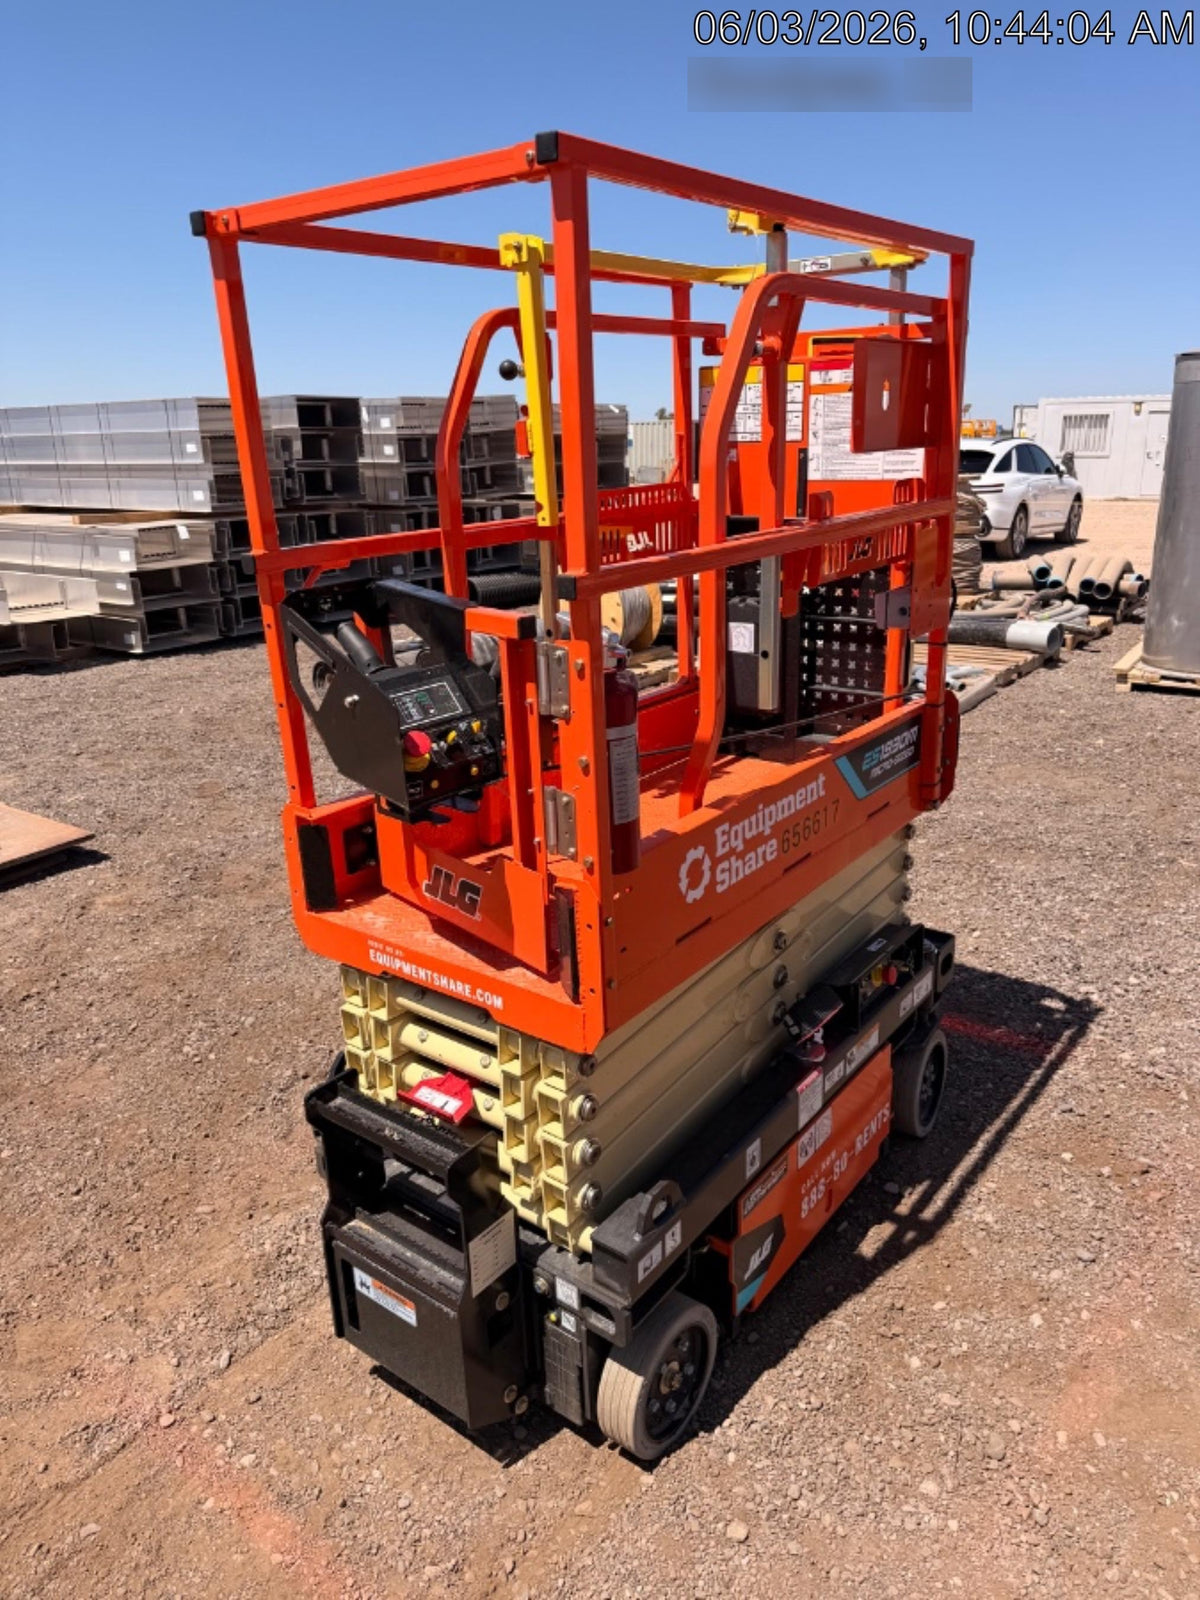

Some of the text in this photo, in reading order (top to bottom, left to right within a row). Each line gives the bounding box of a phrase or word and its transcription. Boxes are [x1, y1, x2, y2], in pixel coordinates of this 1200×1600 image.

[714, 772, 826, 857] Equipment
[780, 800, 841, 855] 656617
[422, 864, 483, 920] JLG
[714, 837, 778, 894] Share
[368, 948, 503, 1011] EQUIPMENTSHARE.COM
